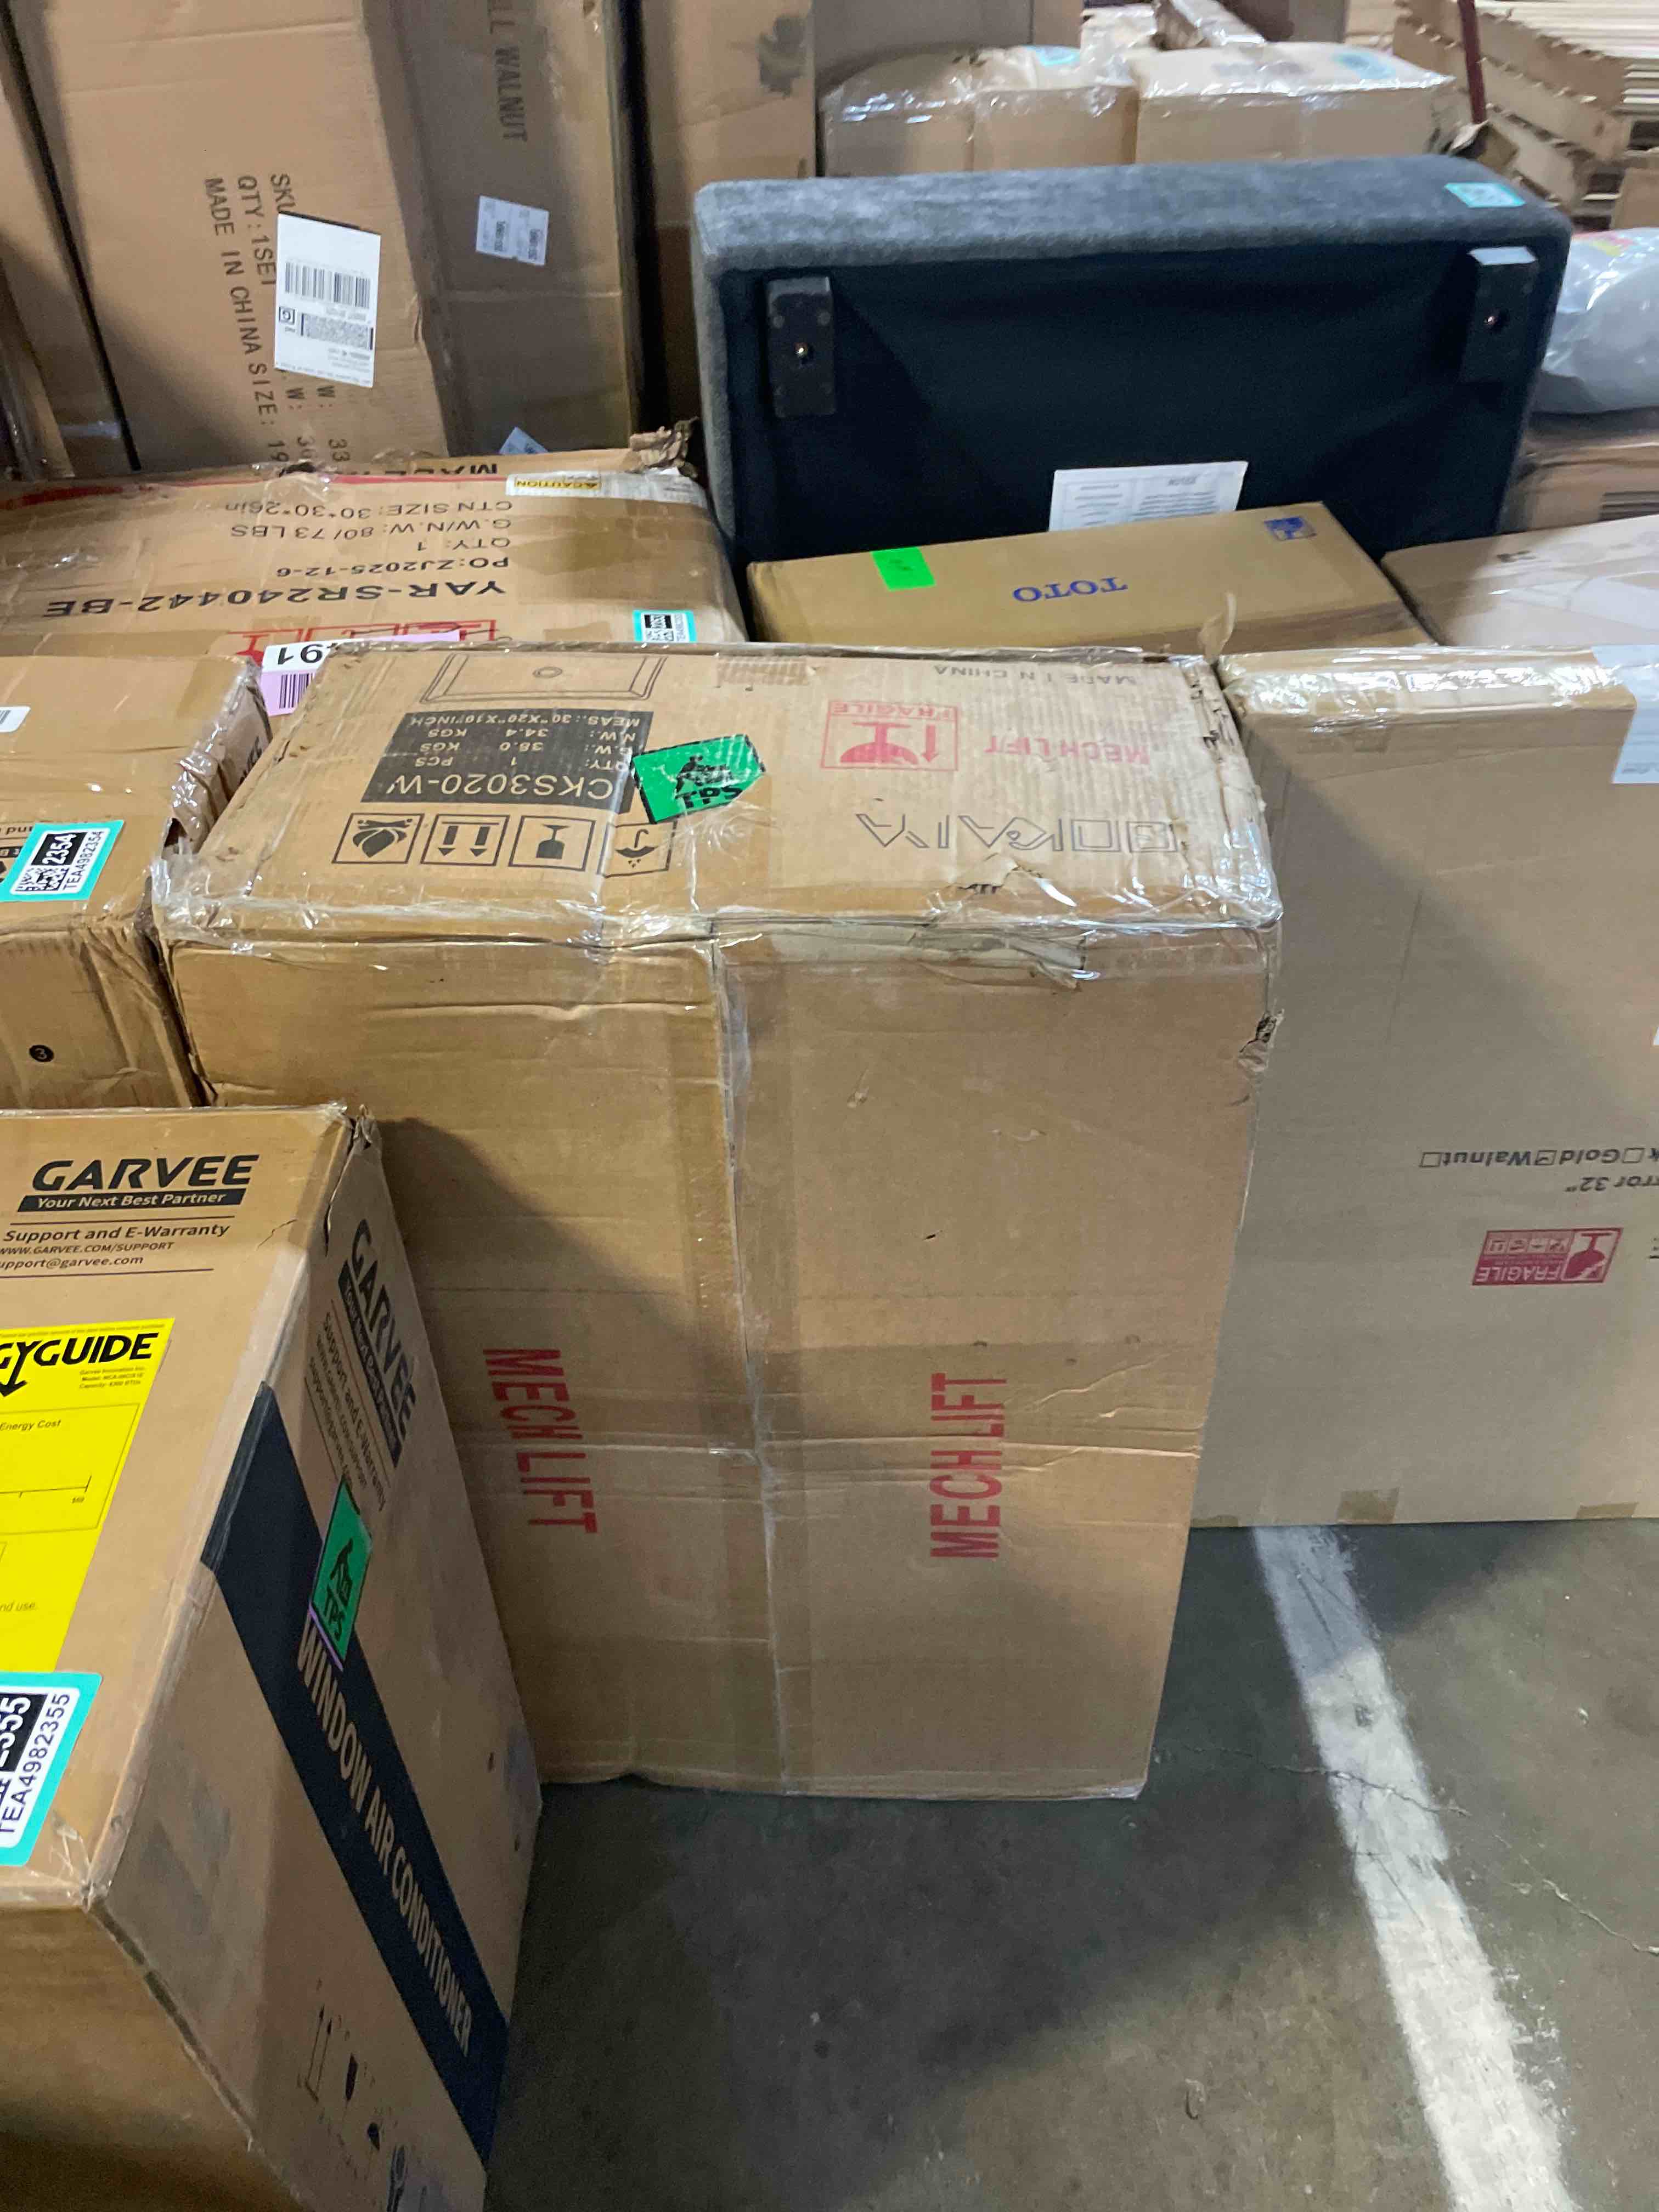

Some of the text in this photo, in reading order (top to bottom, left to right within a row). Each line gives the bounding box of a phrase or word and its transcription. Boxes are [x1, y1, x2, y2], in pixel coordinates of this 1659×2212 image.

[495, 47, 527, 142] WALNUT
[205, 178, 235, 236] MADE
[221, 250, 244, 276] IN
[230, 286, 262, 355] CHINA
[249, 363, 278, 425] SIZE:
[379, 501, 450, 516] SIZE:
[458, 495, 513, 511] CTN
[230, 524, 285, 538] LBS
[417, 537, 511, 551] QTY: 1
[1013, 576, 1128, 602] TOTO
[43, 580, 506, 618] YAR-SR240442-BE
[934, 665, 1007, 679] CHINA
[1065, 675, 1137, 685] MADE
[833, 702, 952, 721] FRAGILE
[427, 728, 467, 738] KGS
[505, 728, 549, 737] 34.4
[420, 742, 461, 752] KGS
[499, 742, 544, 752] 38.0
[1060, 738, 1150, 765] MECH
[414, 756, 454, 767] PCS
[510, 756, 518, 766] 1
[386, 773, 614, 800] CKS3020-W
[675, 785, 743, 809] TPS
[42, 833, 77, 866] 2354
[63, 830, 104, 890] TEA4982354
[1442, 1150, 1531, 1166] Walnut
[1559, 1148, 1620, 1165] Gold
[32, 1154, 260, 1191] GARVEE
[38, 1193, 227, 1208] Your Next Best Partner
[3, 1224, 230, 1244] Support and E-Warranty
[1476, 1265, 1561, 1283] FRAGILE
[37, 1419, 61, 1429] Cost
[482, 1348, 598, 1533] MECH LIFT
[929, 1372, 1007, 1558] MECH LIFT
[297, 1615, 473, 2058] WINDOW AIR CONDITIONER
